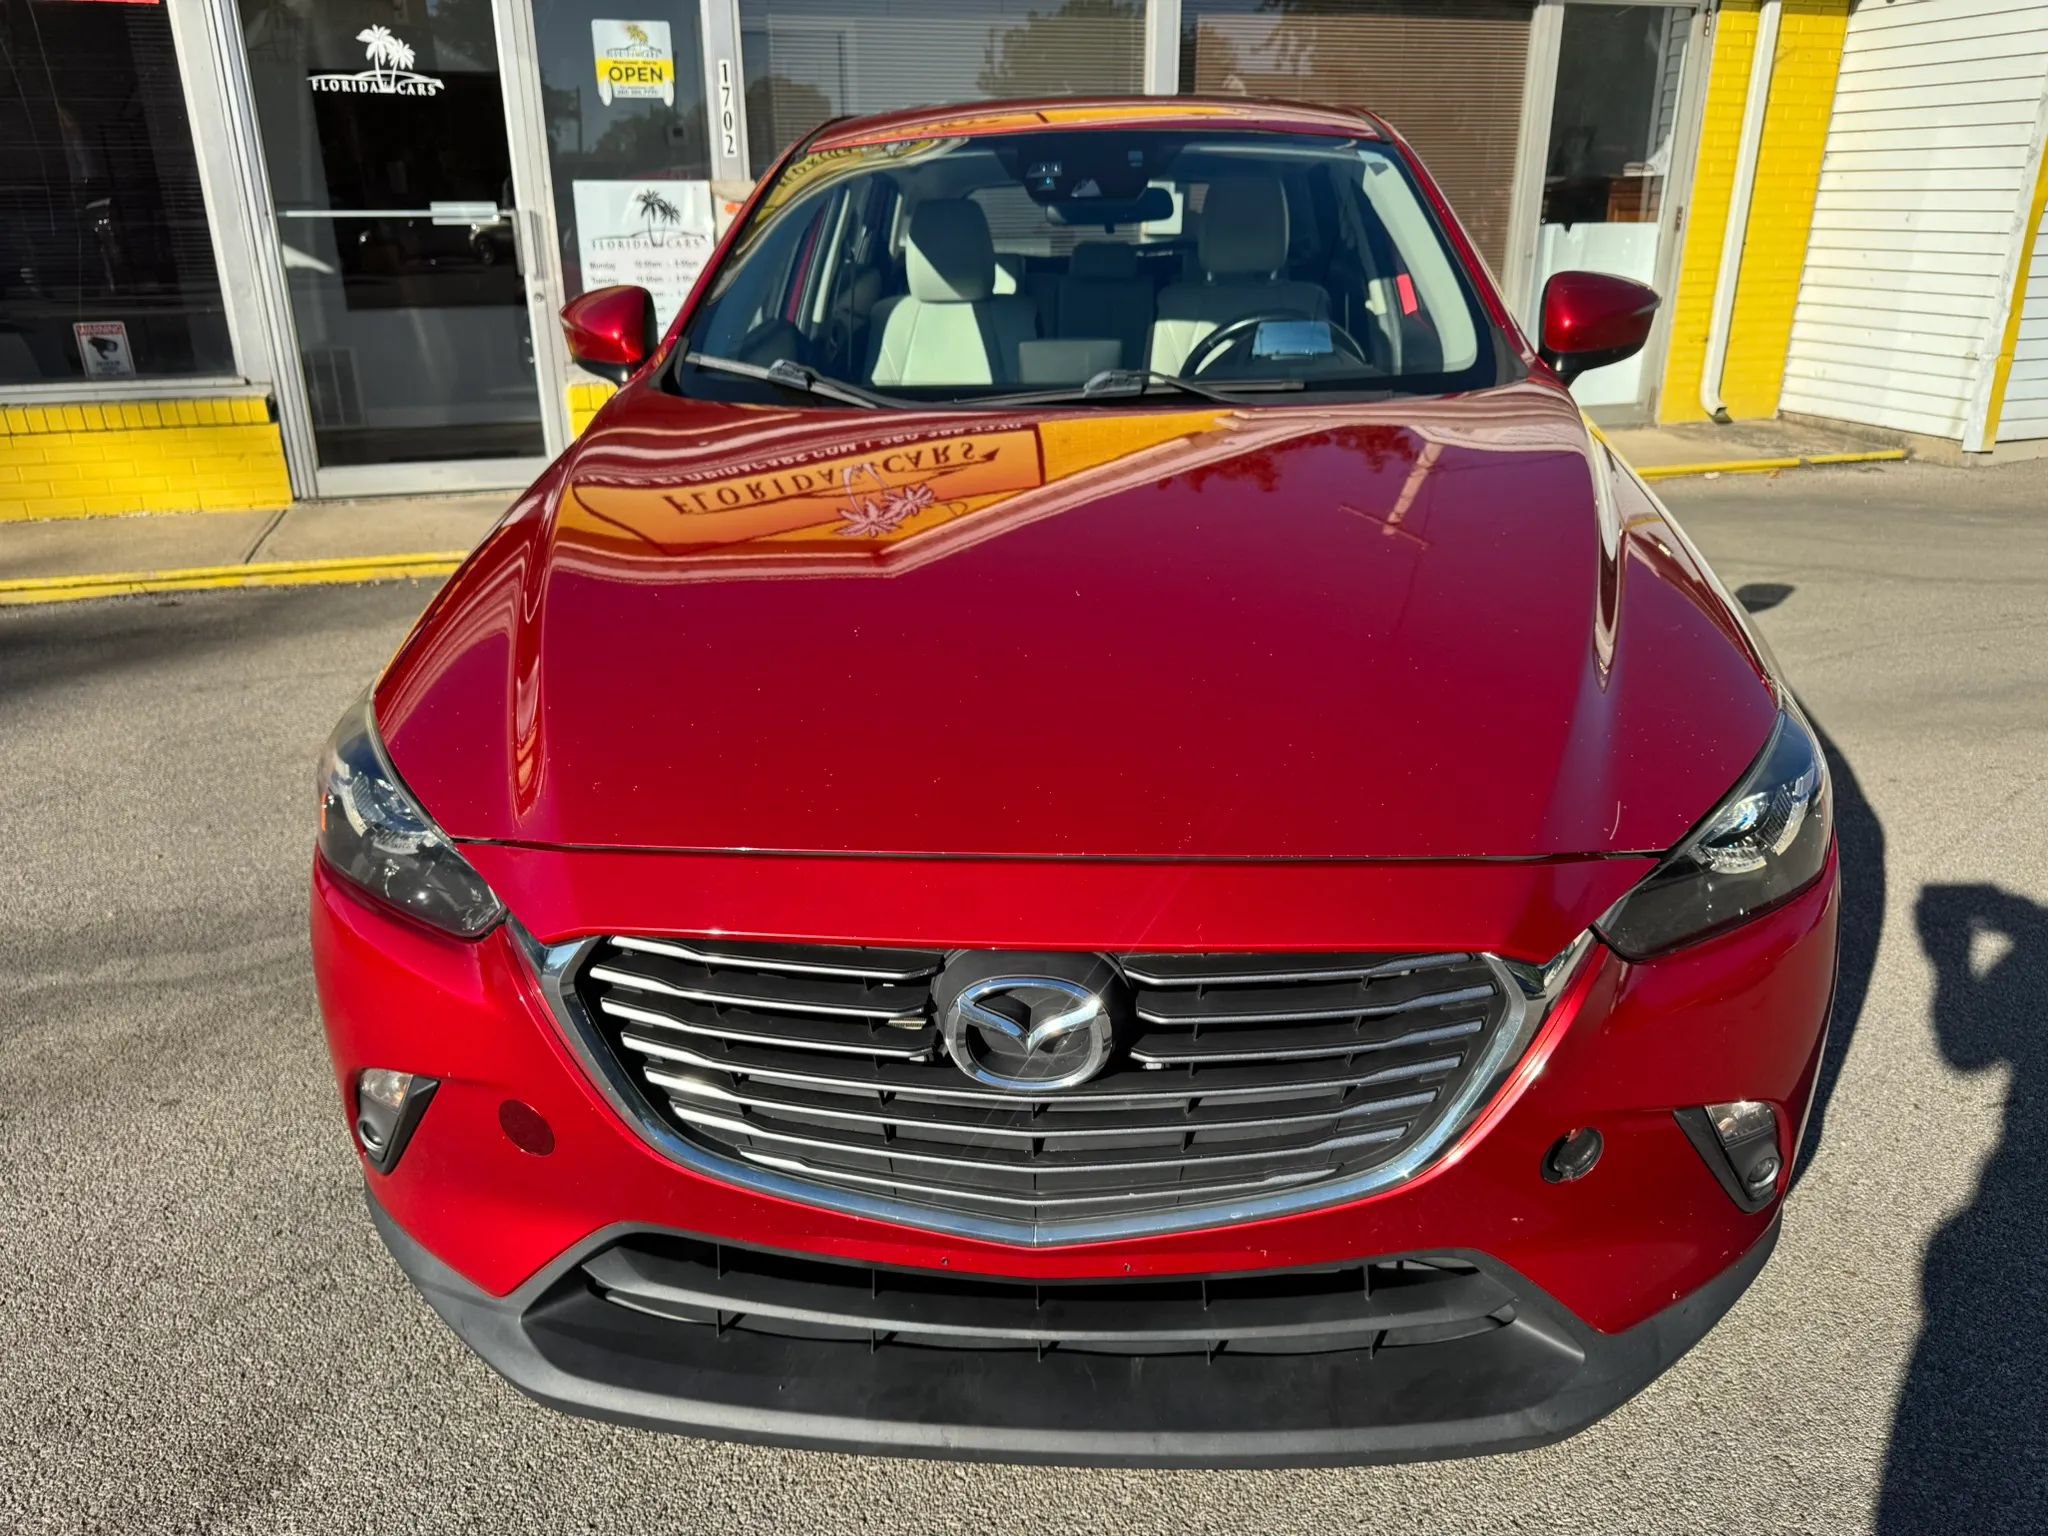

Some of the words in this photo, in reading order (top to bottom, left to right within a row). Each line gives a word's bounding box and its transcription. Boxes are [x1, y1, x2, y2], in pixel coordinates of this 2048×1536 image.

[608, 66, 664, 83] OPEN
[311, 79, 380, 94] FLORIDA
[396, 82, 437, 97] CARS
[721, 63, 735, 154] 1702
[592, 239, 648, 251] FLORIDA
[666, 238, 700, 250] CARS
